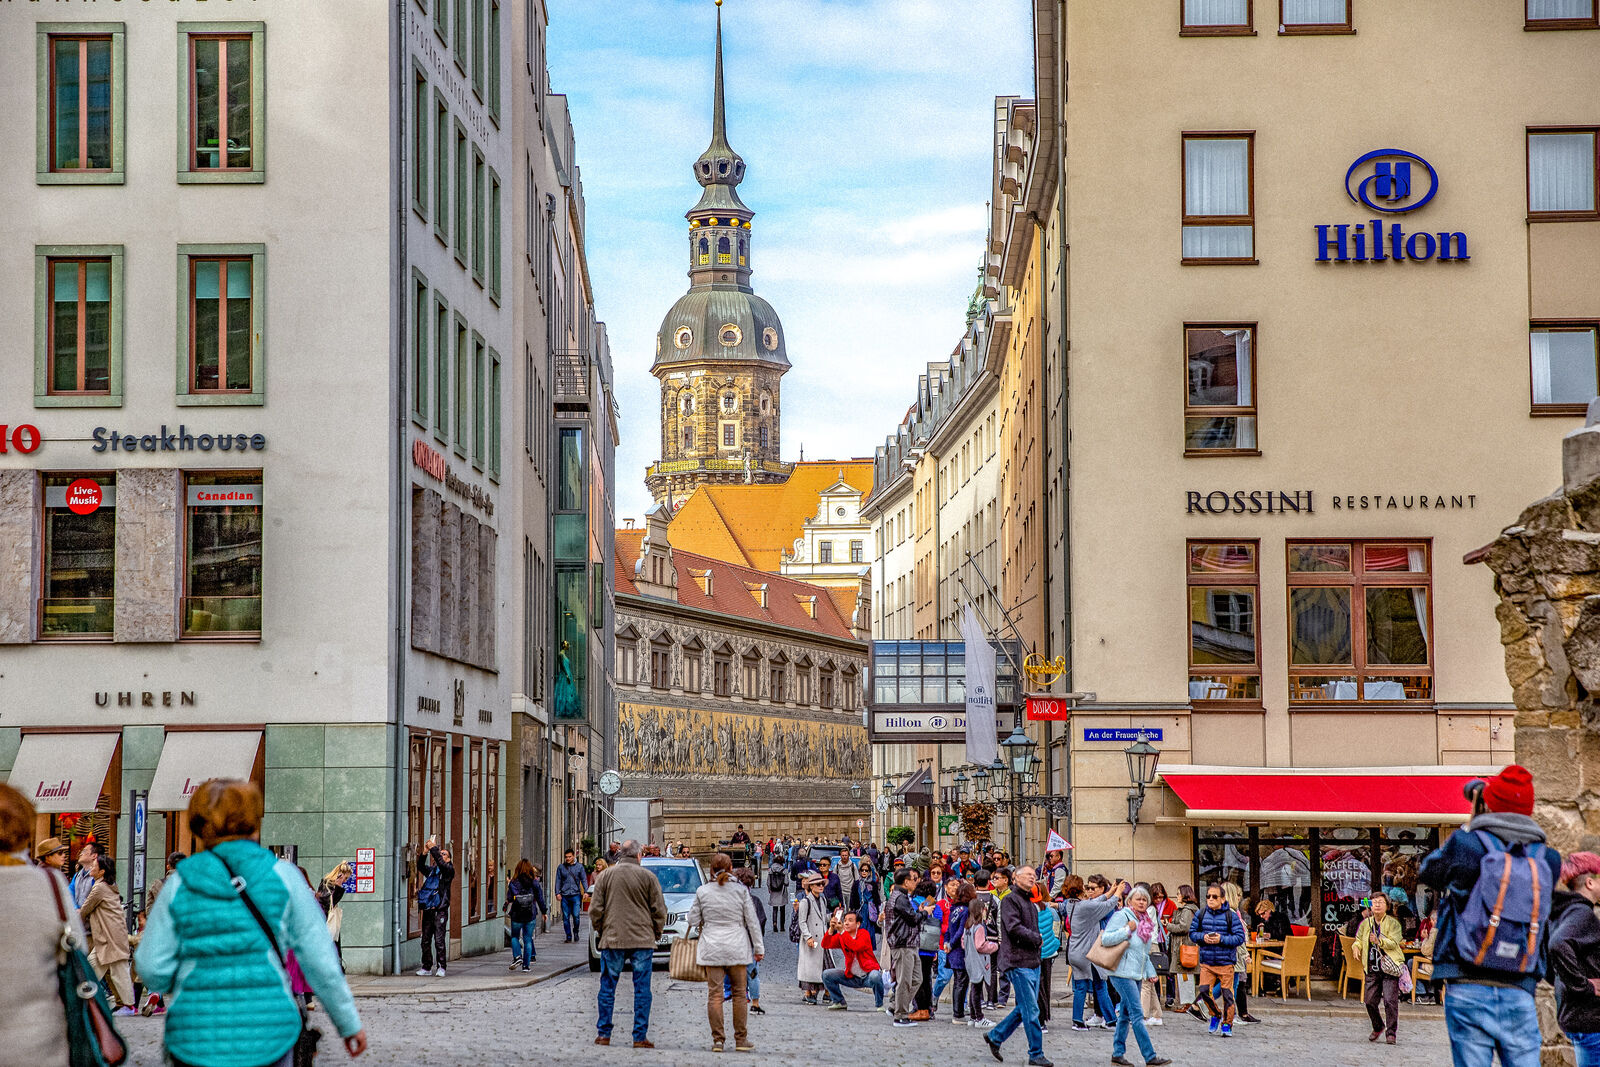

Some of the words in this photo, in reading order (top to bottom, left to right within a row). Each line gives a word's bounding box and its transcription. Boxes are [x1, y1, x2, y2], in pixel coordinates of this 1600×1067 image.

[1314, 220, 1471, 261] Hilton
[92, 425, 265, 452] Steakhouse
[73, 487, 97, 496] Live-
[197, 491, 254, 501] Canadian
[69, 496, 98, 505] Musik
[1186, 490, 1315, 513] ROSSINI
[1333, 495, 1477, 509] RESTAURANT
[95, 691, 194, 706] UHREN
[1033, 700, 1059, 715] BISTRO
[885, 717, 922, 728] Hilton
[1089, 731, 1099, 739] An
[1101, 731, 1113, 739] der
[1115, 731, 1159, 739] Frauenkrche
[1323, 872, 1367, 880] KUCHEN
[1323, 881, 1367, 891] SALATE
